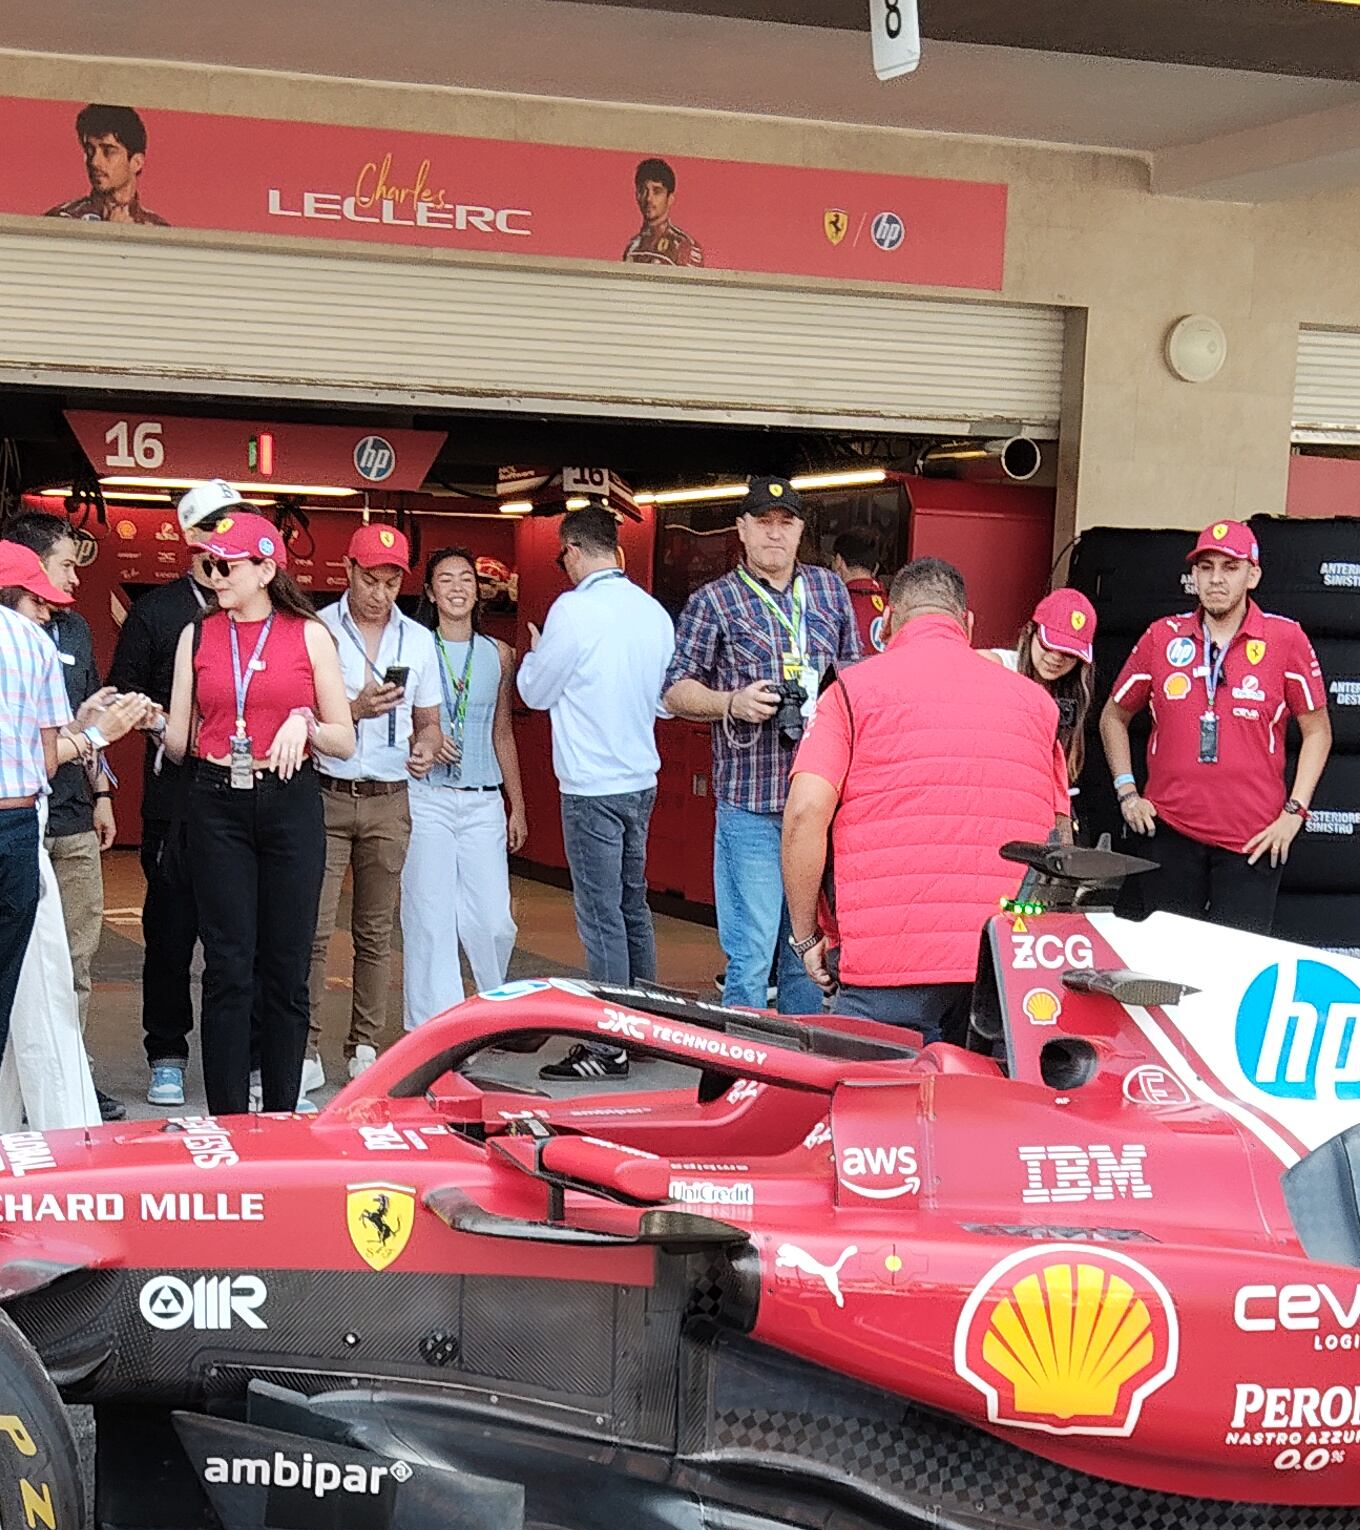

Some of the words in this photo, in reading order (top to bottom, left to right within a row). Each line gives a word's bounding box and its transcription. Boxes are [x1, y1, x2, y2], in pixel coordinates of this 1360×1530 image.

[355, 153, 446, 210] Charles
[268, 188, 533, 236] LECLERC
[104, 420, 165, 469] 16
[1304, 822, 1354, 835] SINISTRO
[597, 1008, 651, 1041] DXC
[652, 1025, 768, 1065] TECHNOLOGY
[842, 1145, 917, 1176] aws
[1016, 1143, 1153, 1204] IBM
[139, 1192, 265, 1222] MILLE
[1225, 1431, 1302, 1447] NASTRO
[203, 1451, 388, 1498] ambipar
